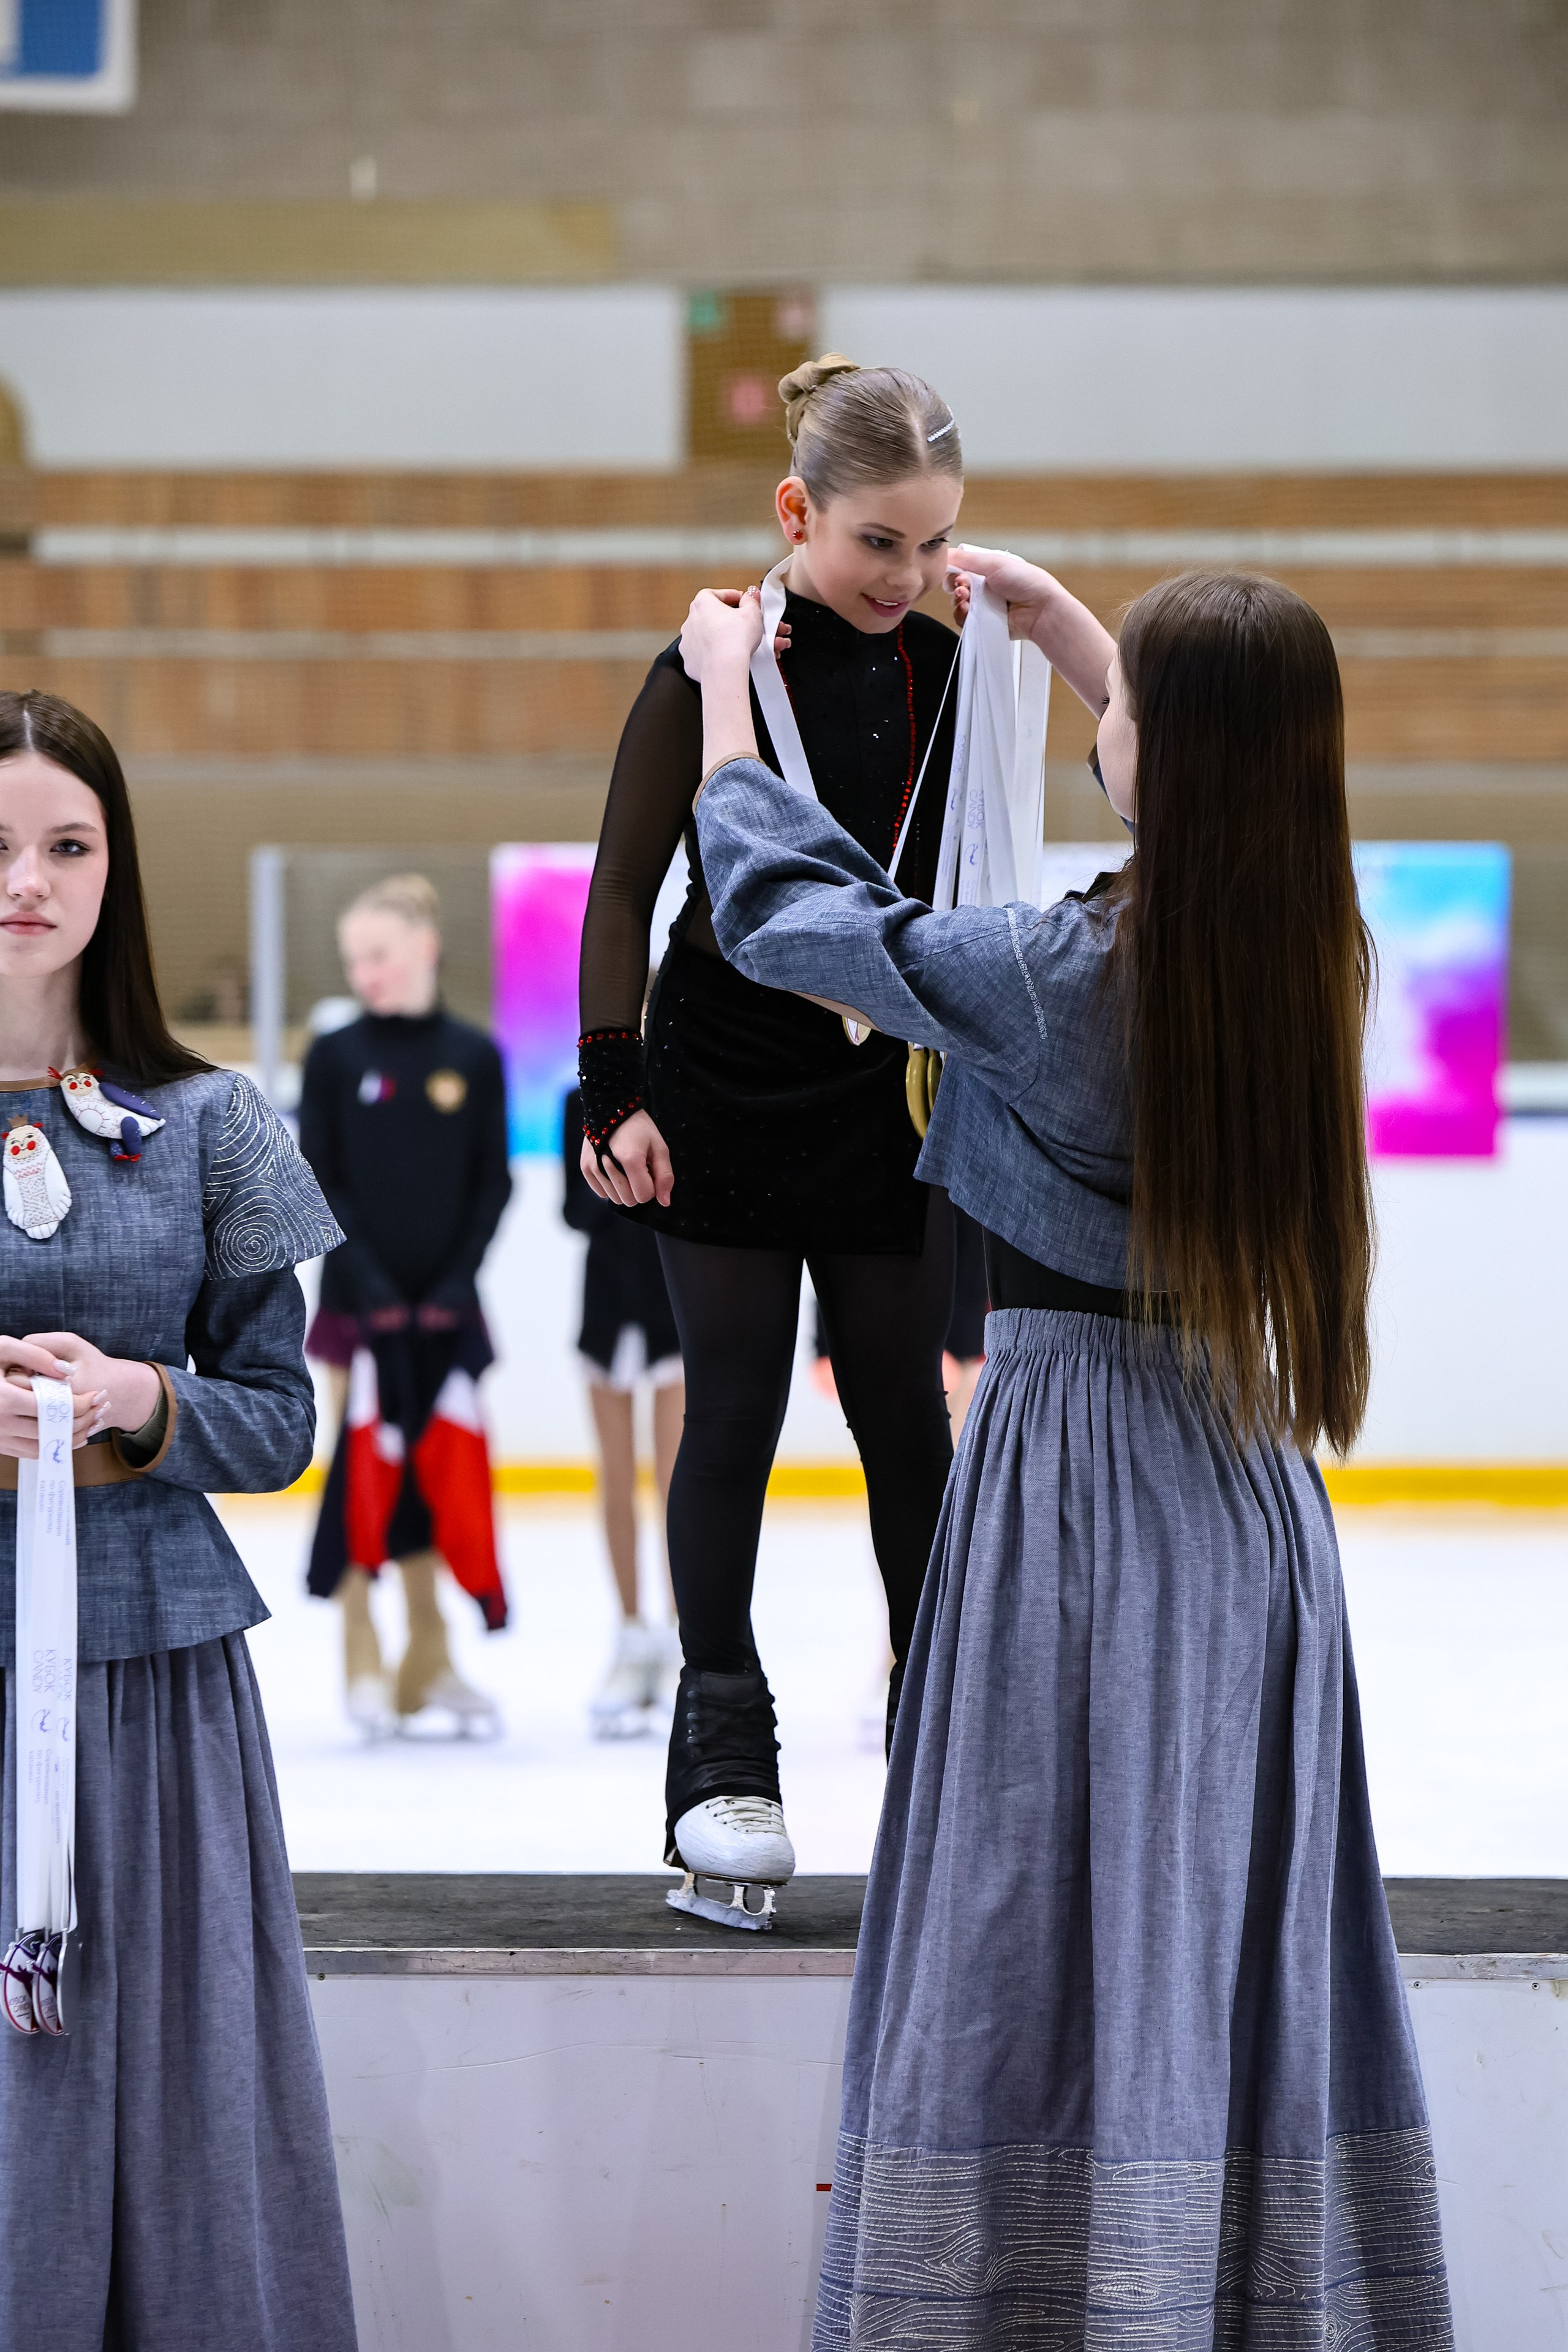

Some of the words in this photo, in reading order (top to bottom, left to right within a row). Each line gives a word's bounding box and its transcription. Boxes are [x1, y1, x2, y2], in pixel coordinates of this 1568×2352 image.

[967, 790, 978, 829] CANDY
[44, 1384, 58, 1423] CANDY
[56, 1383, 70, 1423] КУБОК
[49, 1480, 56, 1490] по
[45, 1491, 56, 1534] фигурному
[56, 1480, 67, 1537] Соревнования
[32, 1650, 45, 1694] CANDY
[44, 1649, 57, 1692] КУБОК
[64, 1659, 72, 1701] КУБОК
